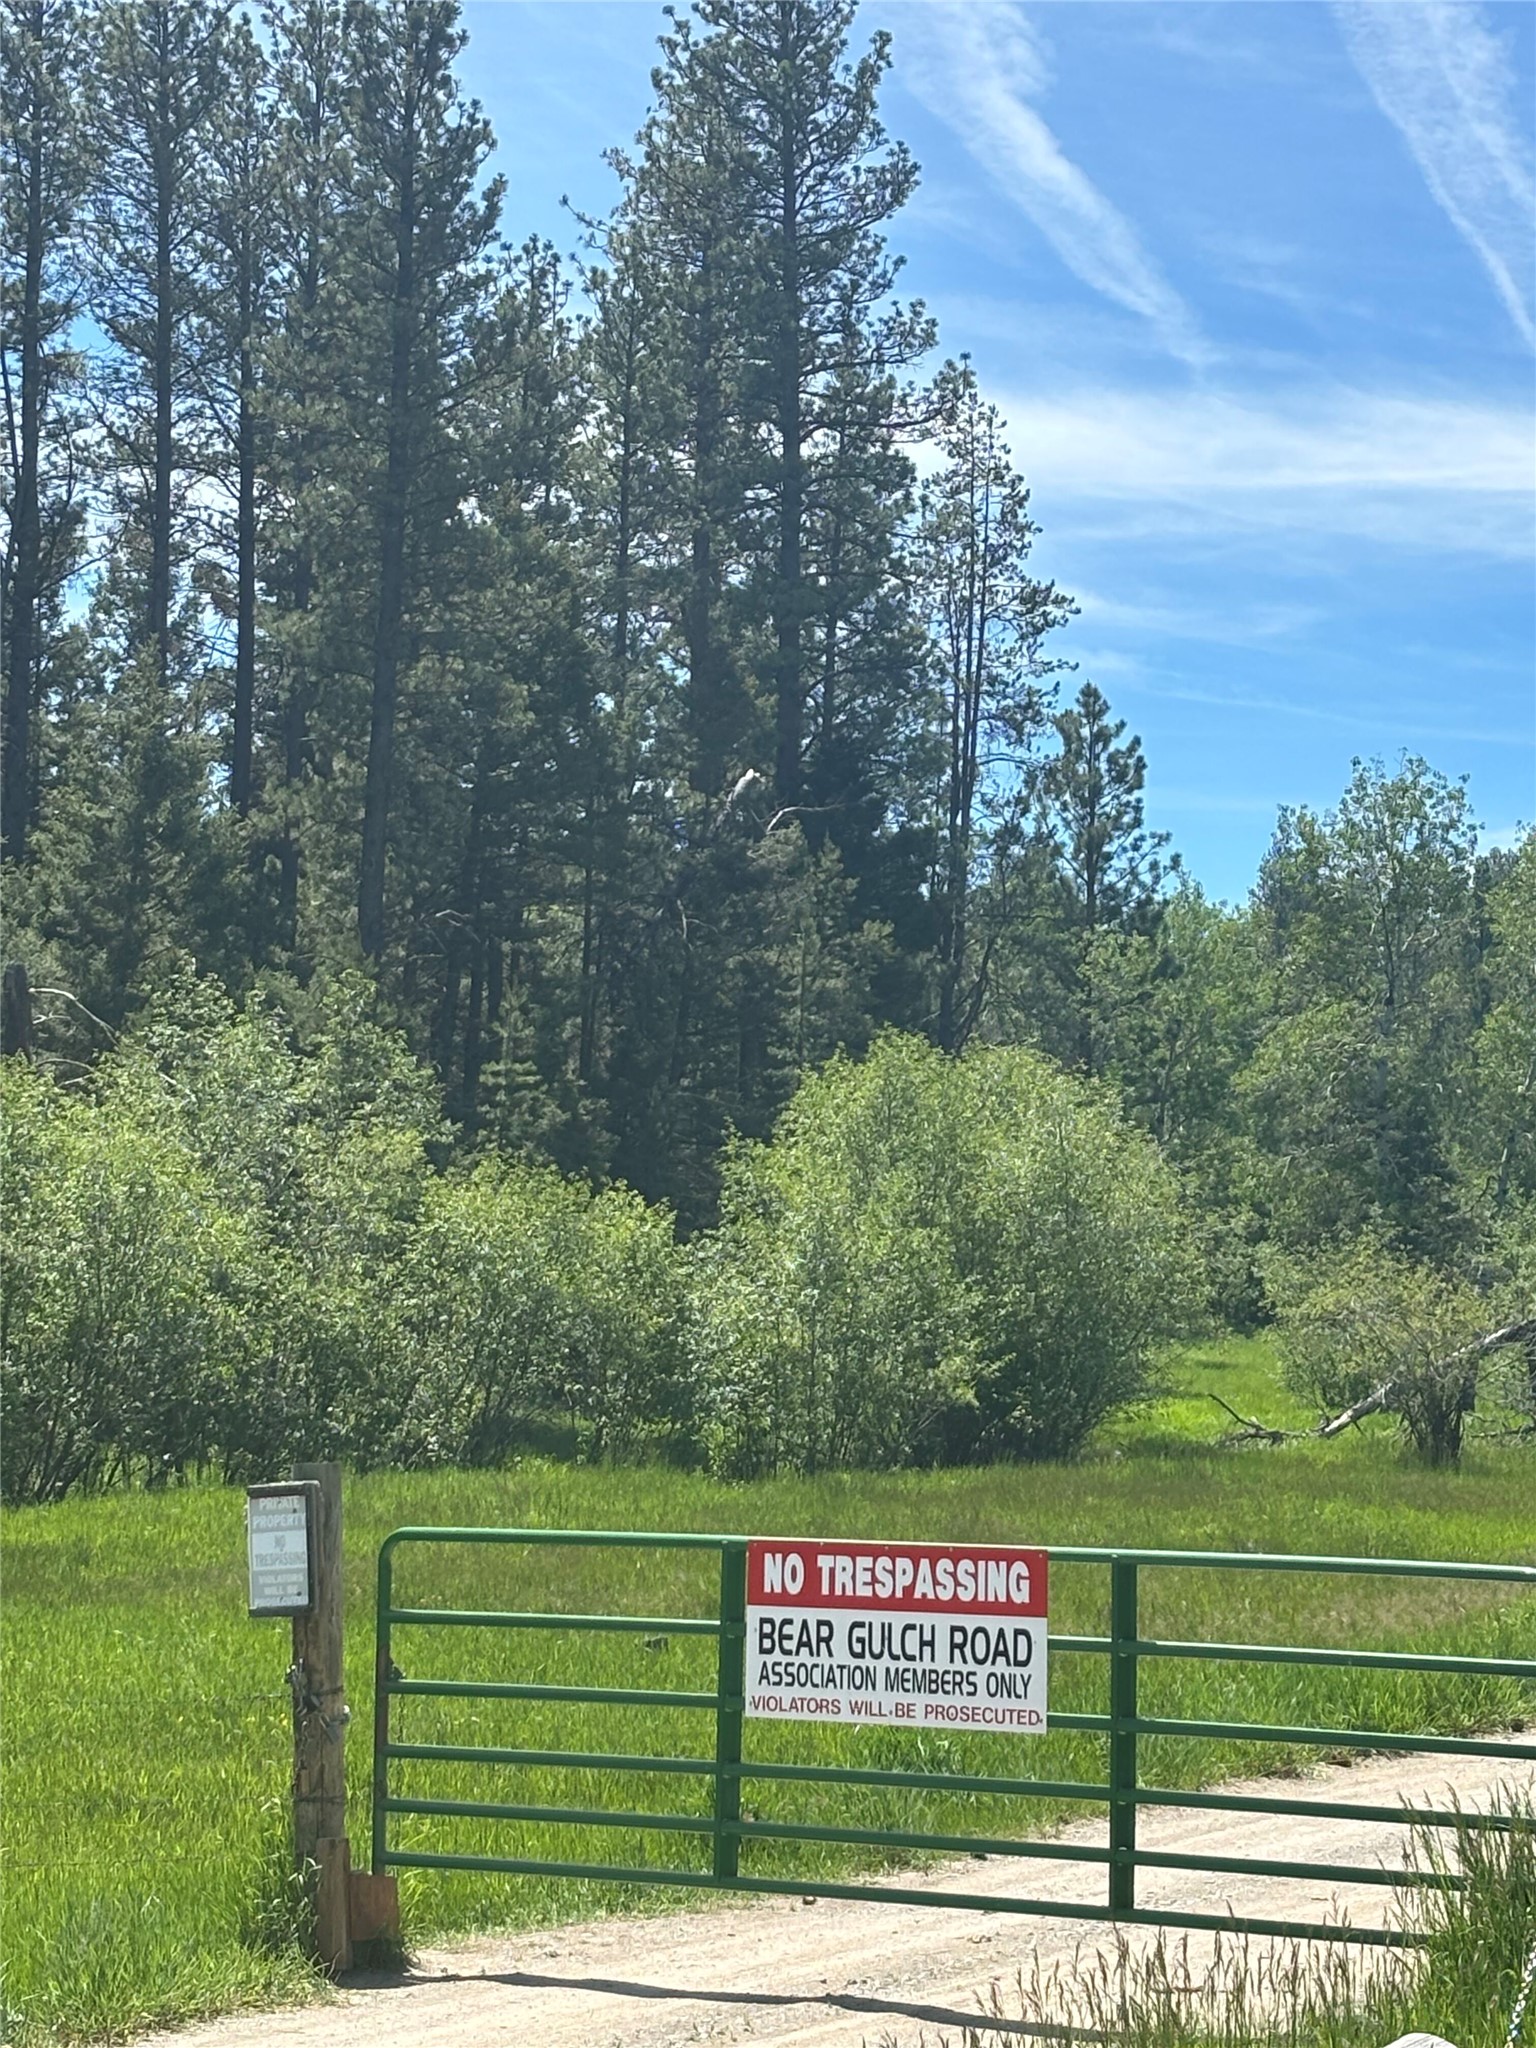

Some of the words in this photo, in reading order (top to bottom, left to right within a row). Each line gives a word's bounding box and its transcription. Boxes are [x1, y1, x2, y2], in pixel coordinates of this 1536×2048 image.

[259, 1495, 300, 1510] PRIVATE
[253, 1514, 306, 1529] PROPERTY
[274, 1534, 287, 1550] NO
[763, 1553, 805, 1596] NO
[817, 1554, 1031, 1604] TRESPASSING
[758, 1617, 834, 1658] BEAR
[847, 1620, 936, 1663] GULCH
[949, 1625, 1033, 1667] ROAD
[758, 1660, 877, 1691] ASSOCIATION
[884, 1666, 978, 1697] MEMBERS
[985, 1671, 1033, 1700] ONLY
[752, 1695, 841, 1715] VIOLATORS
[849, 1699, 889, 1718] WILL
[894, 1702, 917, 1719] BE
[924, 1704, 1041, 1726] PROSECUTED
